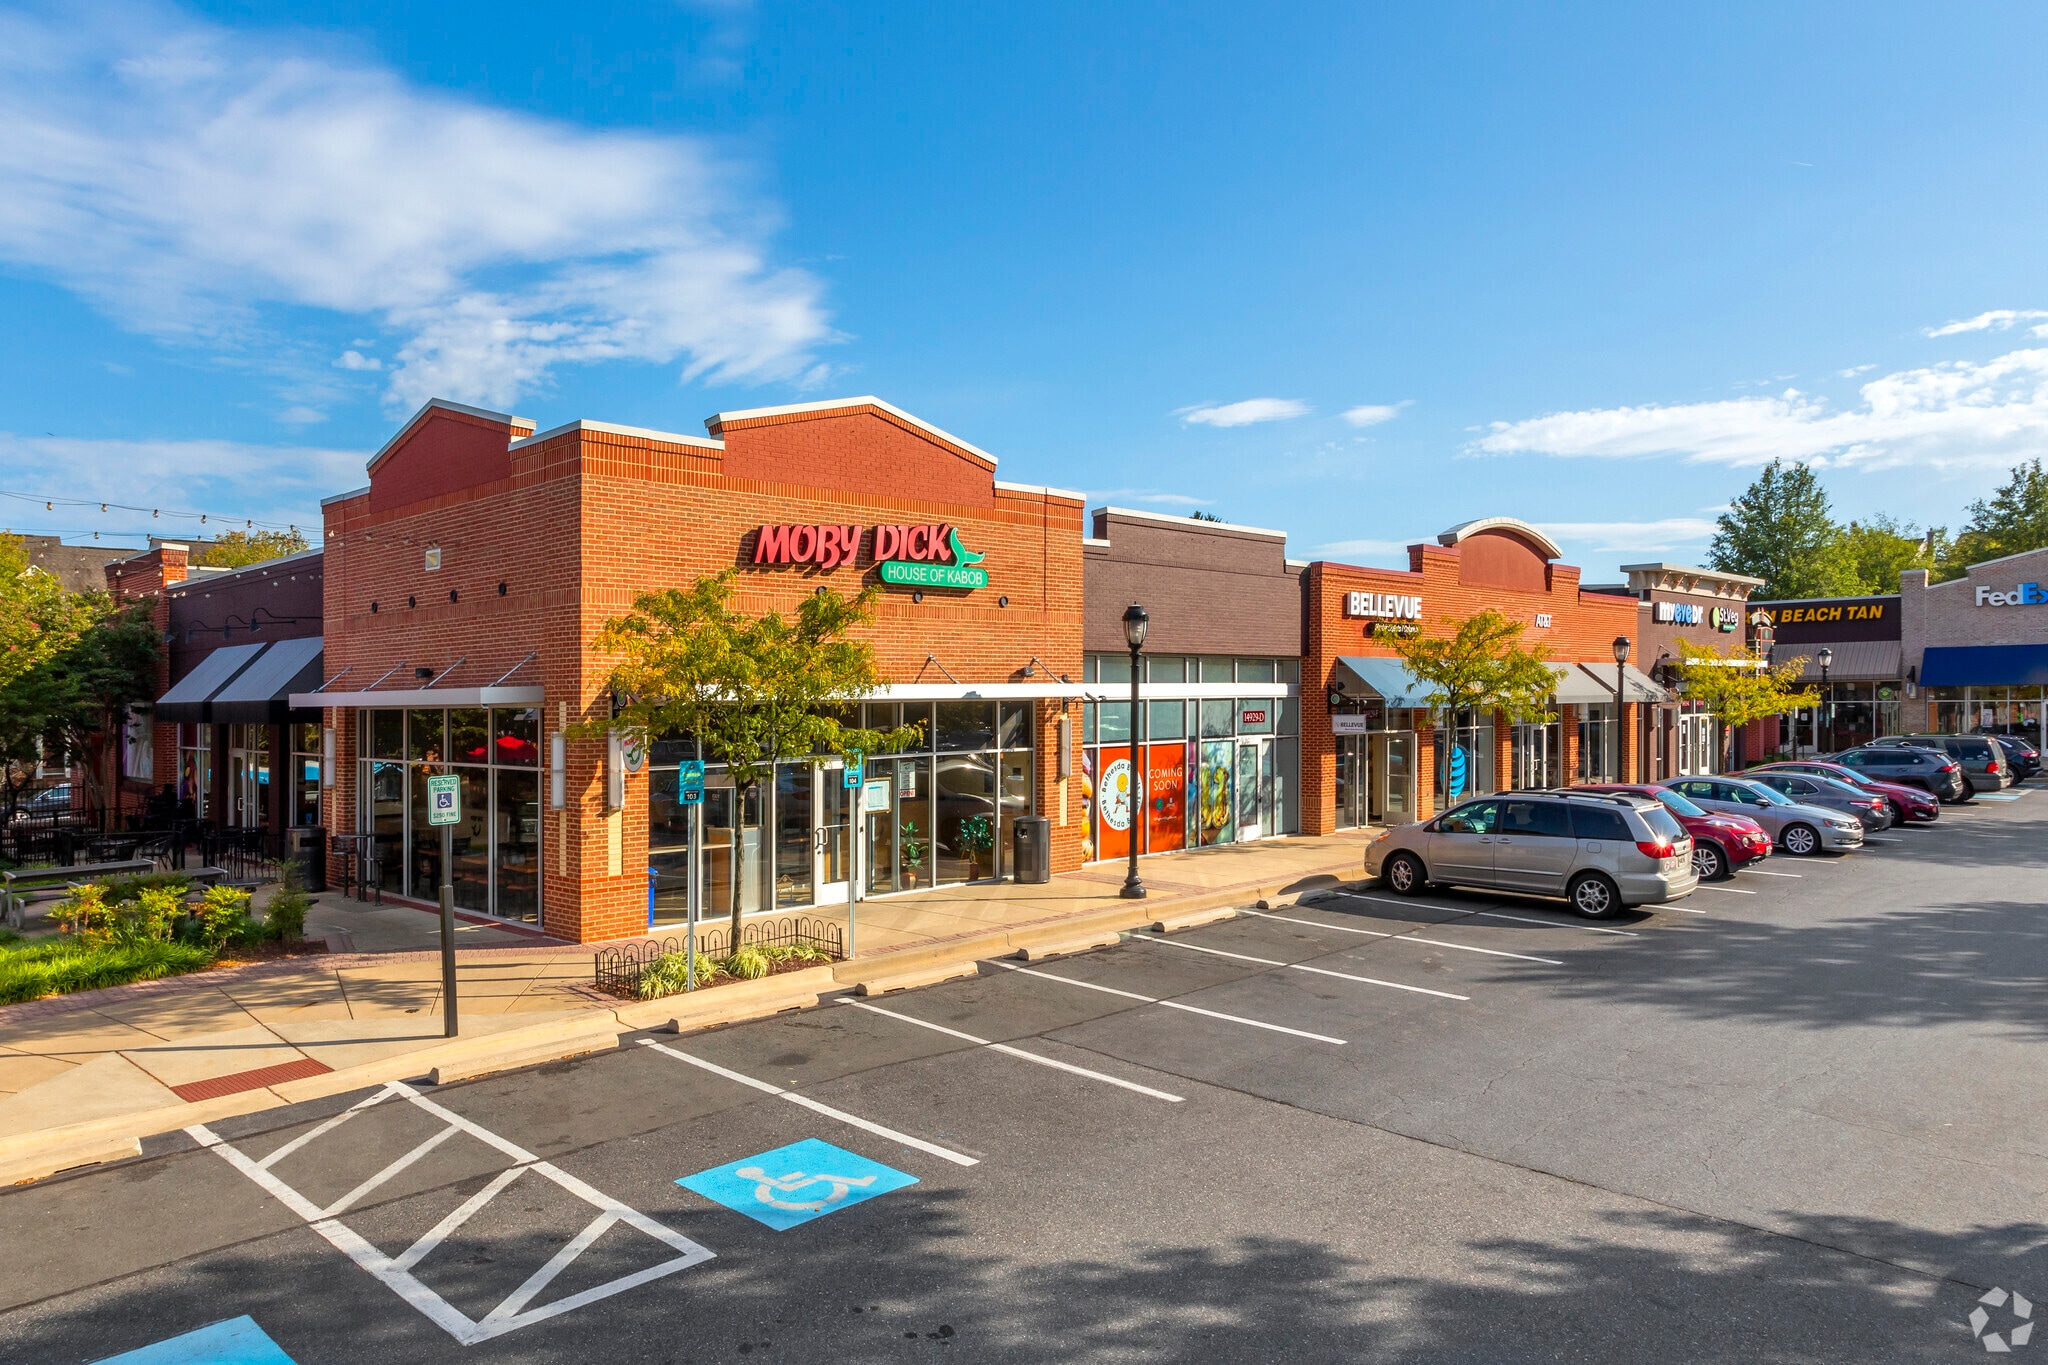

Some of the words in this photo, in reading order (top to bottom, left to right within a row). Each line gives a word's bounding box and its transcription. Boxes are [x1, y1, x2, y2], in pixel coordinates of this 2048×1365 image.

[754, 525, 863, 569] MOBY
[874, 523, 951, 562] DICK
[888, 565, 927, 582] HOUSE
[930, 568, 945, 583] OF
[947, 569, 983, 585] KABOB
[1349, 592, 1422, 619] BELLEVUE
[1781, 607, 1842, 623] BEACH
[1847, 605, 1883, 620] TAN
[1536, 613, 1552, 628] AT&T
[1243, 712, 1265, 722] 14929-D
[1101, 762, 1125, 793] Bethesda
[1149, 767, 1183, 779] COMING
[1153, 780, 1178, 791] SOON
[1101, 799, 1125, 828] Bethesda
